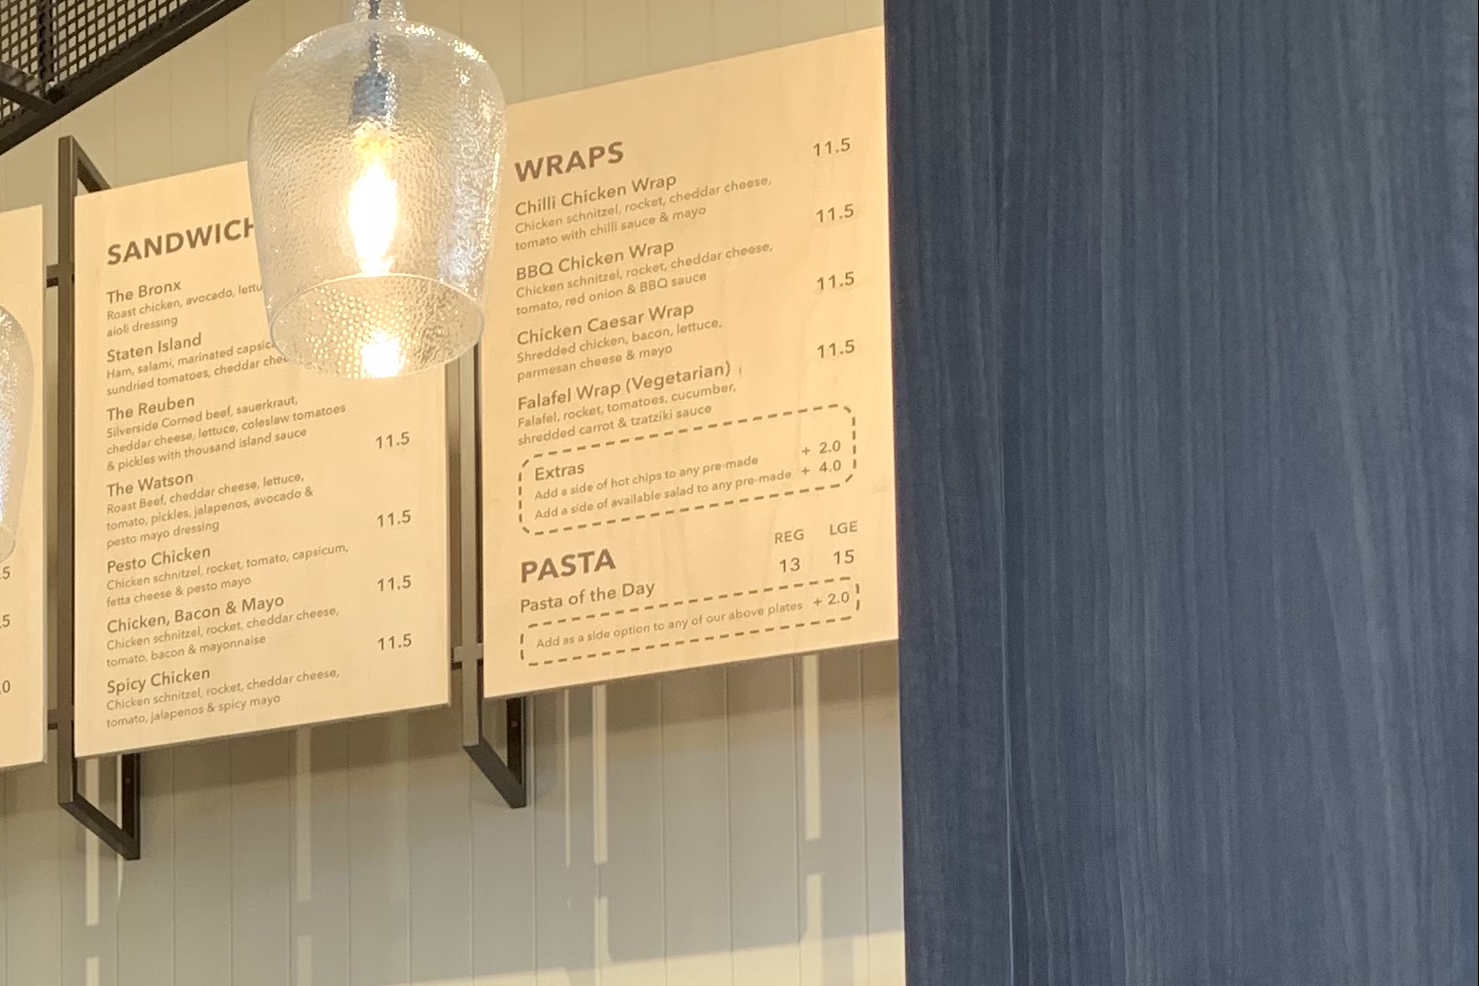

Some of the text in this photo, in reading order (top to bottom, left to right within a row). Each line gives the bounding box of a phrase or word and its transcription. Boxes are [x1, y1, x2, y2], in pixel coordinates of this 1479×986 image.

[812, 137, 850, 156] 11.5
[514, 142, 624, 181] WRAPS
[514, 176, 676, 216] Chilli Chicken Wrap
[658, 211, 669, 223] &
[816, 203, 854, 223] 11.5
[107, 218, 254, 265] SANDWICH
[516, 242, 674, 281] BBQ Chicken Wrap
[626, 283, 636, 295] &
[816, 271, 854, 290] 11.5
[106, 281, 181, 304] The Bronx
[516, 304, 694, 345] Chicken Caesar Wrap
[106, 331, 202, 363] Staten Island
[816, 339, 855, 358] 11.5
[518, 361, 730, 410] Falafel Wrap (Vegetarian)
[106, 396, 195, 421] The Reuben
[617, 416, 628, 428] &
[375, 431, 410, 449] 11.5
[818, 439, 841, 454] 2.0
[534, 463, 585, 481] Extras
[818, 459, 842, 473] 4.0
[106, 473, 193, 497] The Watson
[376, 509, 411, 527] 11.5
[774, 528, 804, 544] REG
[829, 520, 858, 536] LGE
[107, 547, 211, 573] Pesto Chicken
[779, 557, 800, 573] 13
[833, 549, 854, 564] 15
[521, 550, 616, 583] PASTA
[376, 574, 411, 592] 11.5
[520, 583, 655, 613] Pasta of the Day
[827, 591, 850, 605] 2.0
[106, 596, 284, 633] Chicken, Bacon & Mayo
[377, 633, 412, 650] 11.5
[106, 668, 210, 696] Spicy Chicken
[206, 701, 216, 713] &
